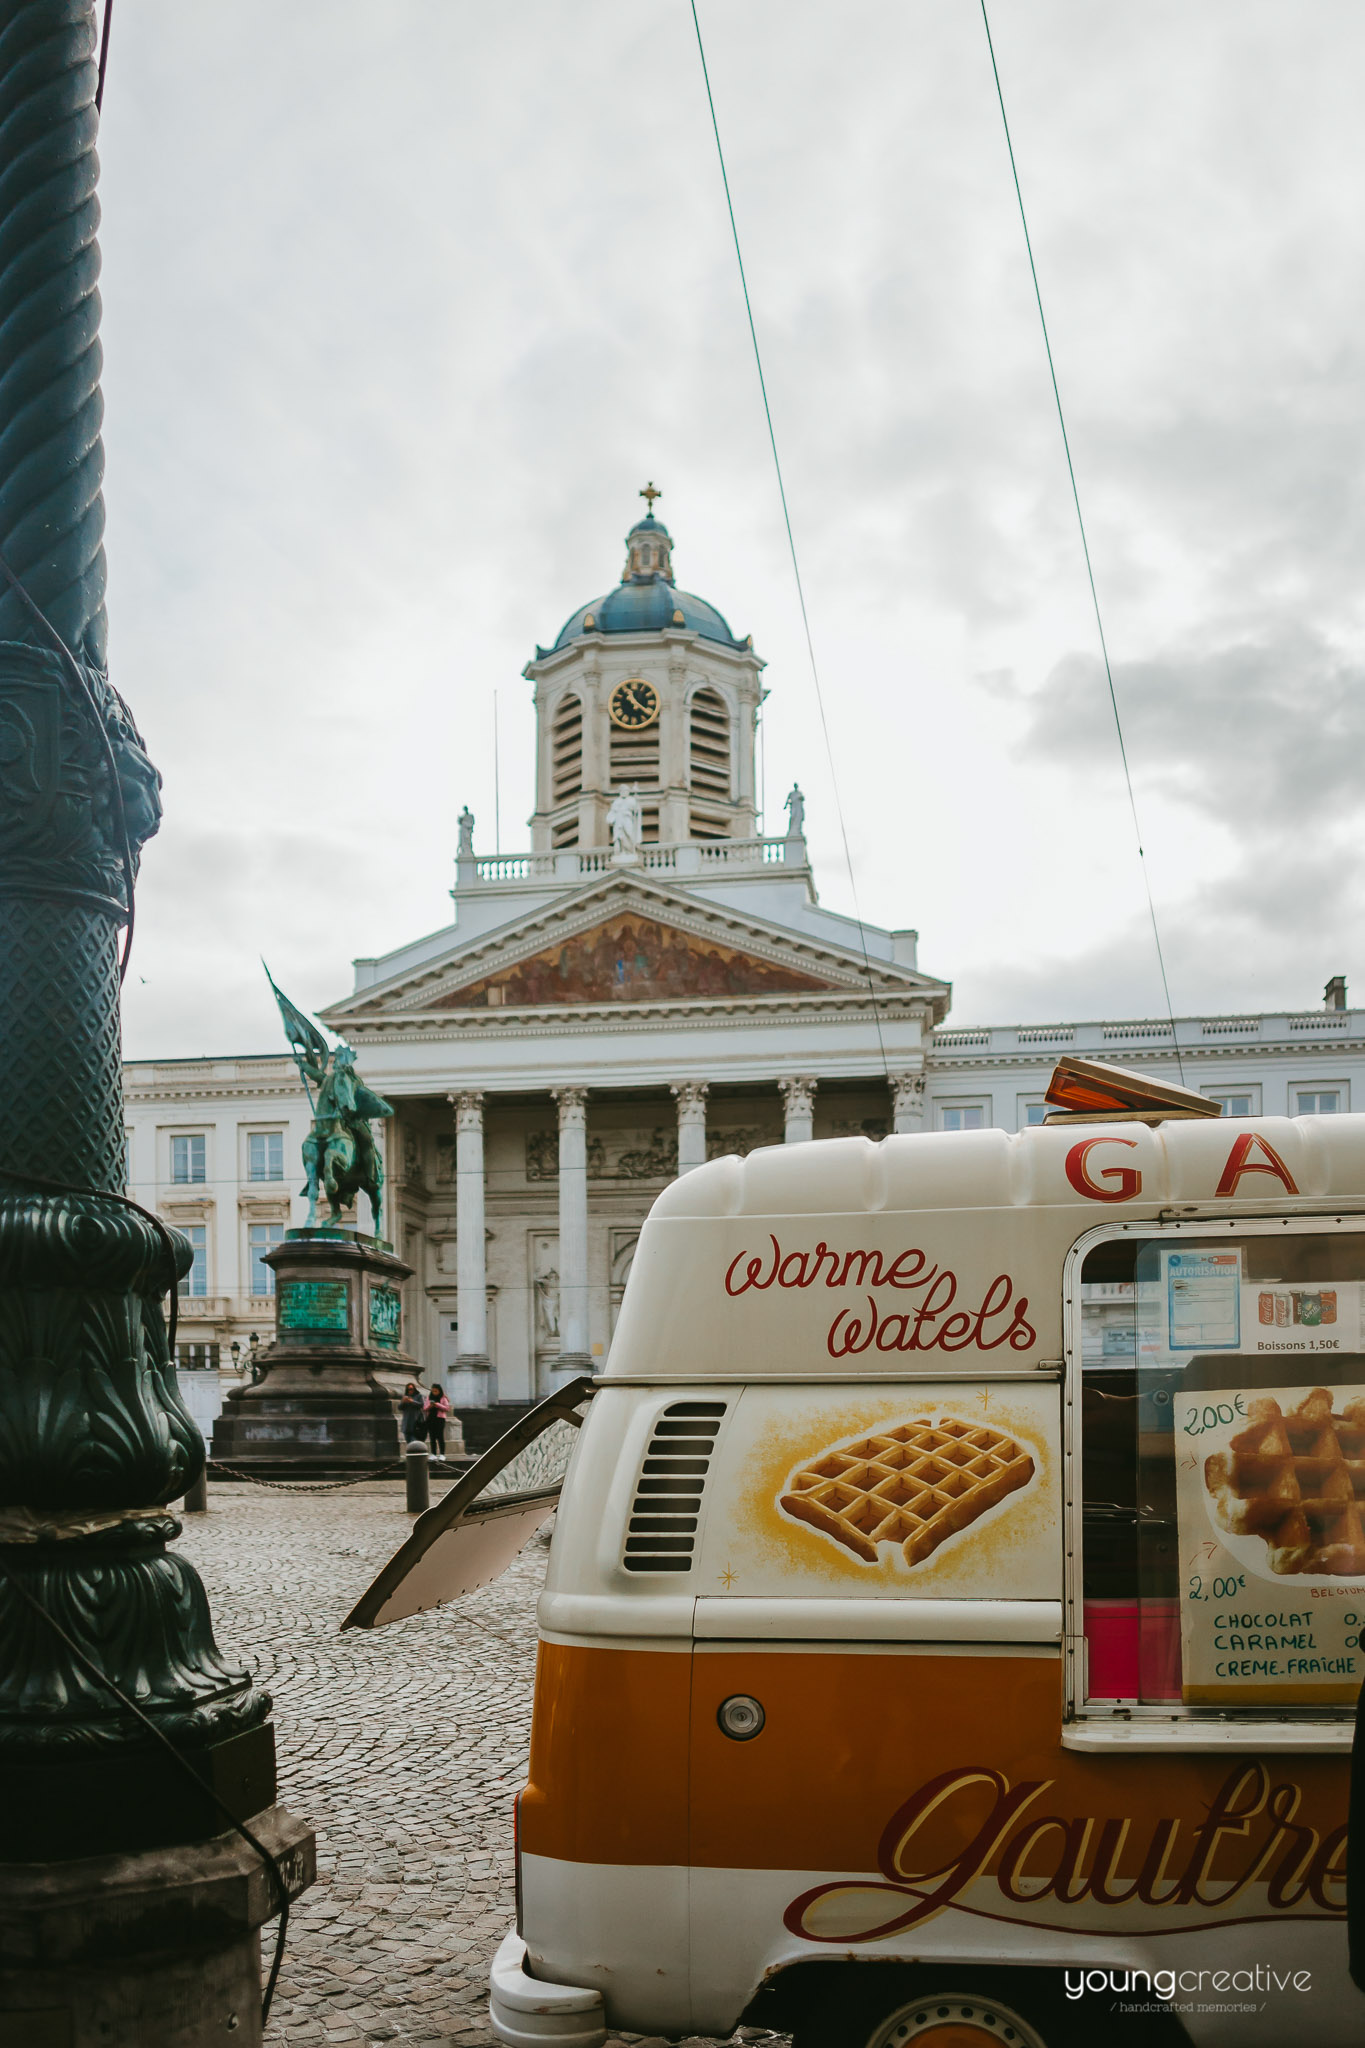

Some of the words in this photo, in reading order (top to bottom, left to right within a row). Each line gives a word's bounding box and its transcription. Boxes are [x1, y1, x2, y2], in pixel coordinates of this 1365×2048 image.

[1169, 1265, 1238, 1277] AUTORISATION
[1257, 1341, 1306, 1351] Boissons
[1309, 1339, 1340, 1351] 1,50€
[1184, 1393, 1249, 1436] 2,00€
[1189, 1574, 1246, 1601] 2,00€
[1310, 1587, 1365, 1598] BELGIUM
[1214, 1611, 1313, 1628] CHOCOLAT
[1214, 1633, 1317, 1650] CARAMEL
